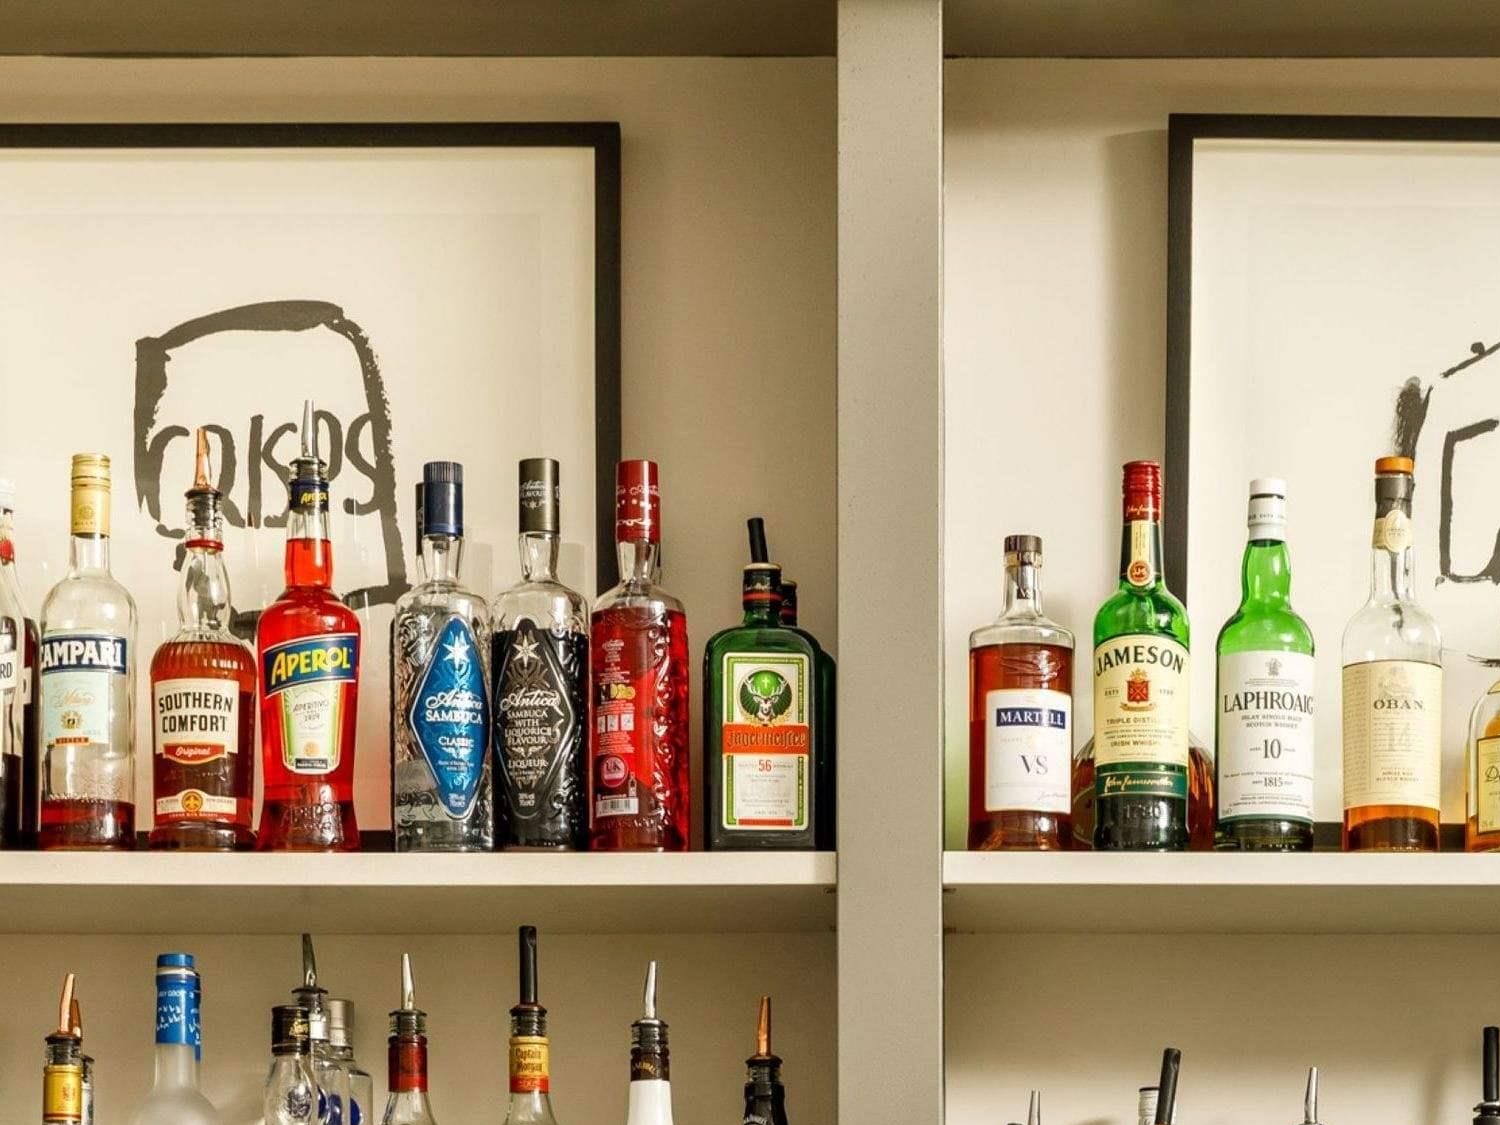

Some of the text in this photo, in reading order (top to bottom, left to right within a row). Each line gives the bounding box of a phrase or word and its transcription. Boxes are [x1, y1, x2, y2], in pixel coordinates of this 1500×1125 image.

[271, 649, 350, 687] APEROL
[1096, 645, 1185, 677] JAMESON
[159, 691, 233, 713] SOUTHERN
[1223, 690, 1314, 716] LAPHROAIG
[1373, 698, 1424, 711] OBAN
[162, 715, 227, 733] COMFORT
[425, 710, 482, 724] SAMBUCA
[1263, 738, 1281, 760] 10
[758, 759, 772, 772] 56
[1020, 754, 1049, 776] VS
[1264, 777, 1283, 788] 1815
